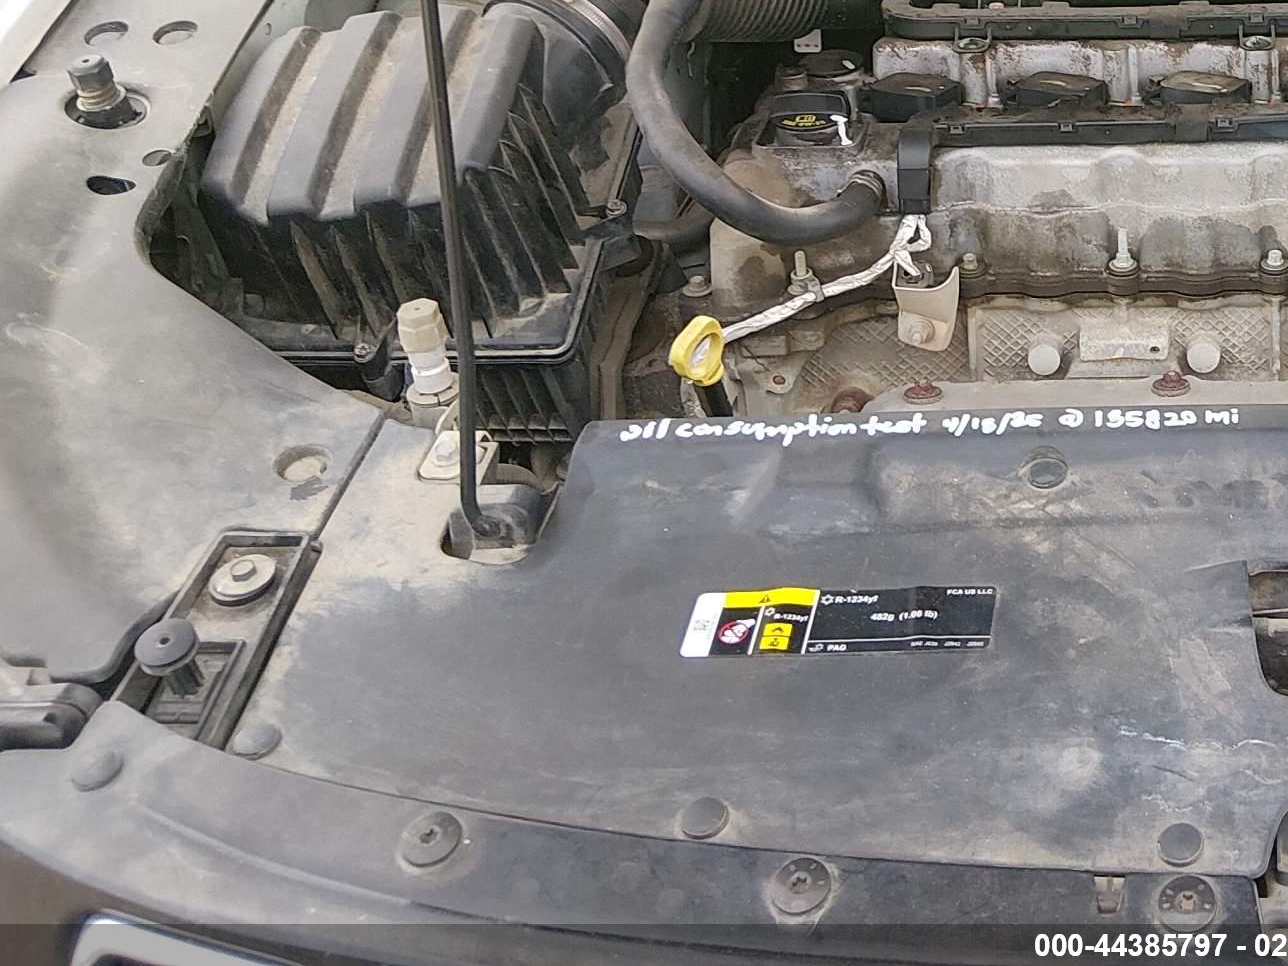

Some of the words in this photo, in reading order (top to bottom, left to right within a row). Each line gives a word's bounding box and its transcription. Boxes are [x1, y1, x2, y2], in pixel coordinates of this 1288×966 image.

[674, 413, 857, 448] consumption
[859, 412, 928, 437] test
[1058, 408, 1084, 428] @
[946, 588, 964, 596] FCA
[977, 588, 994, 596] LLC
